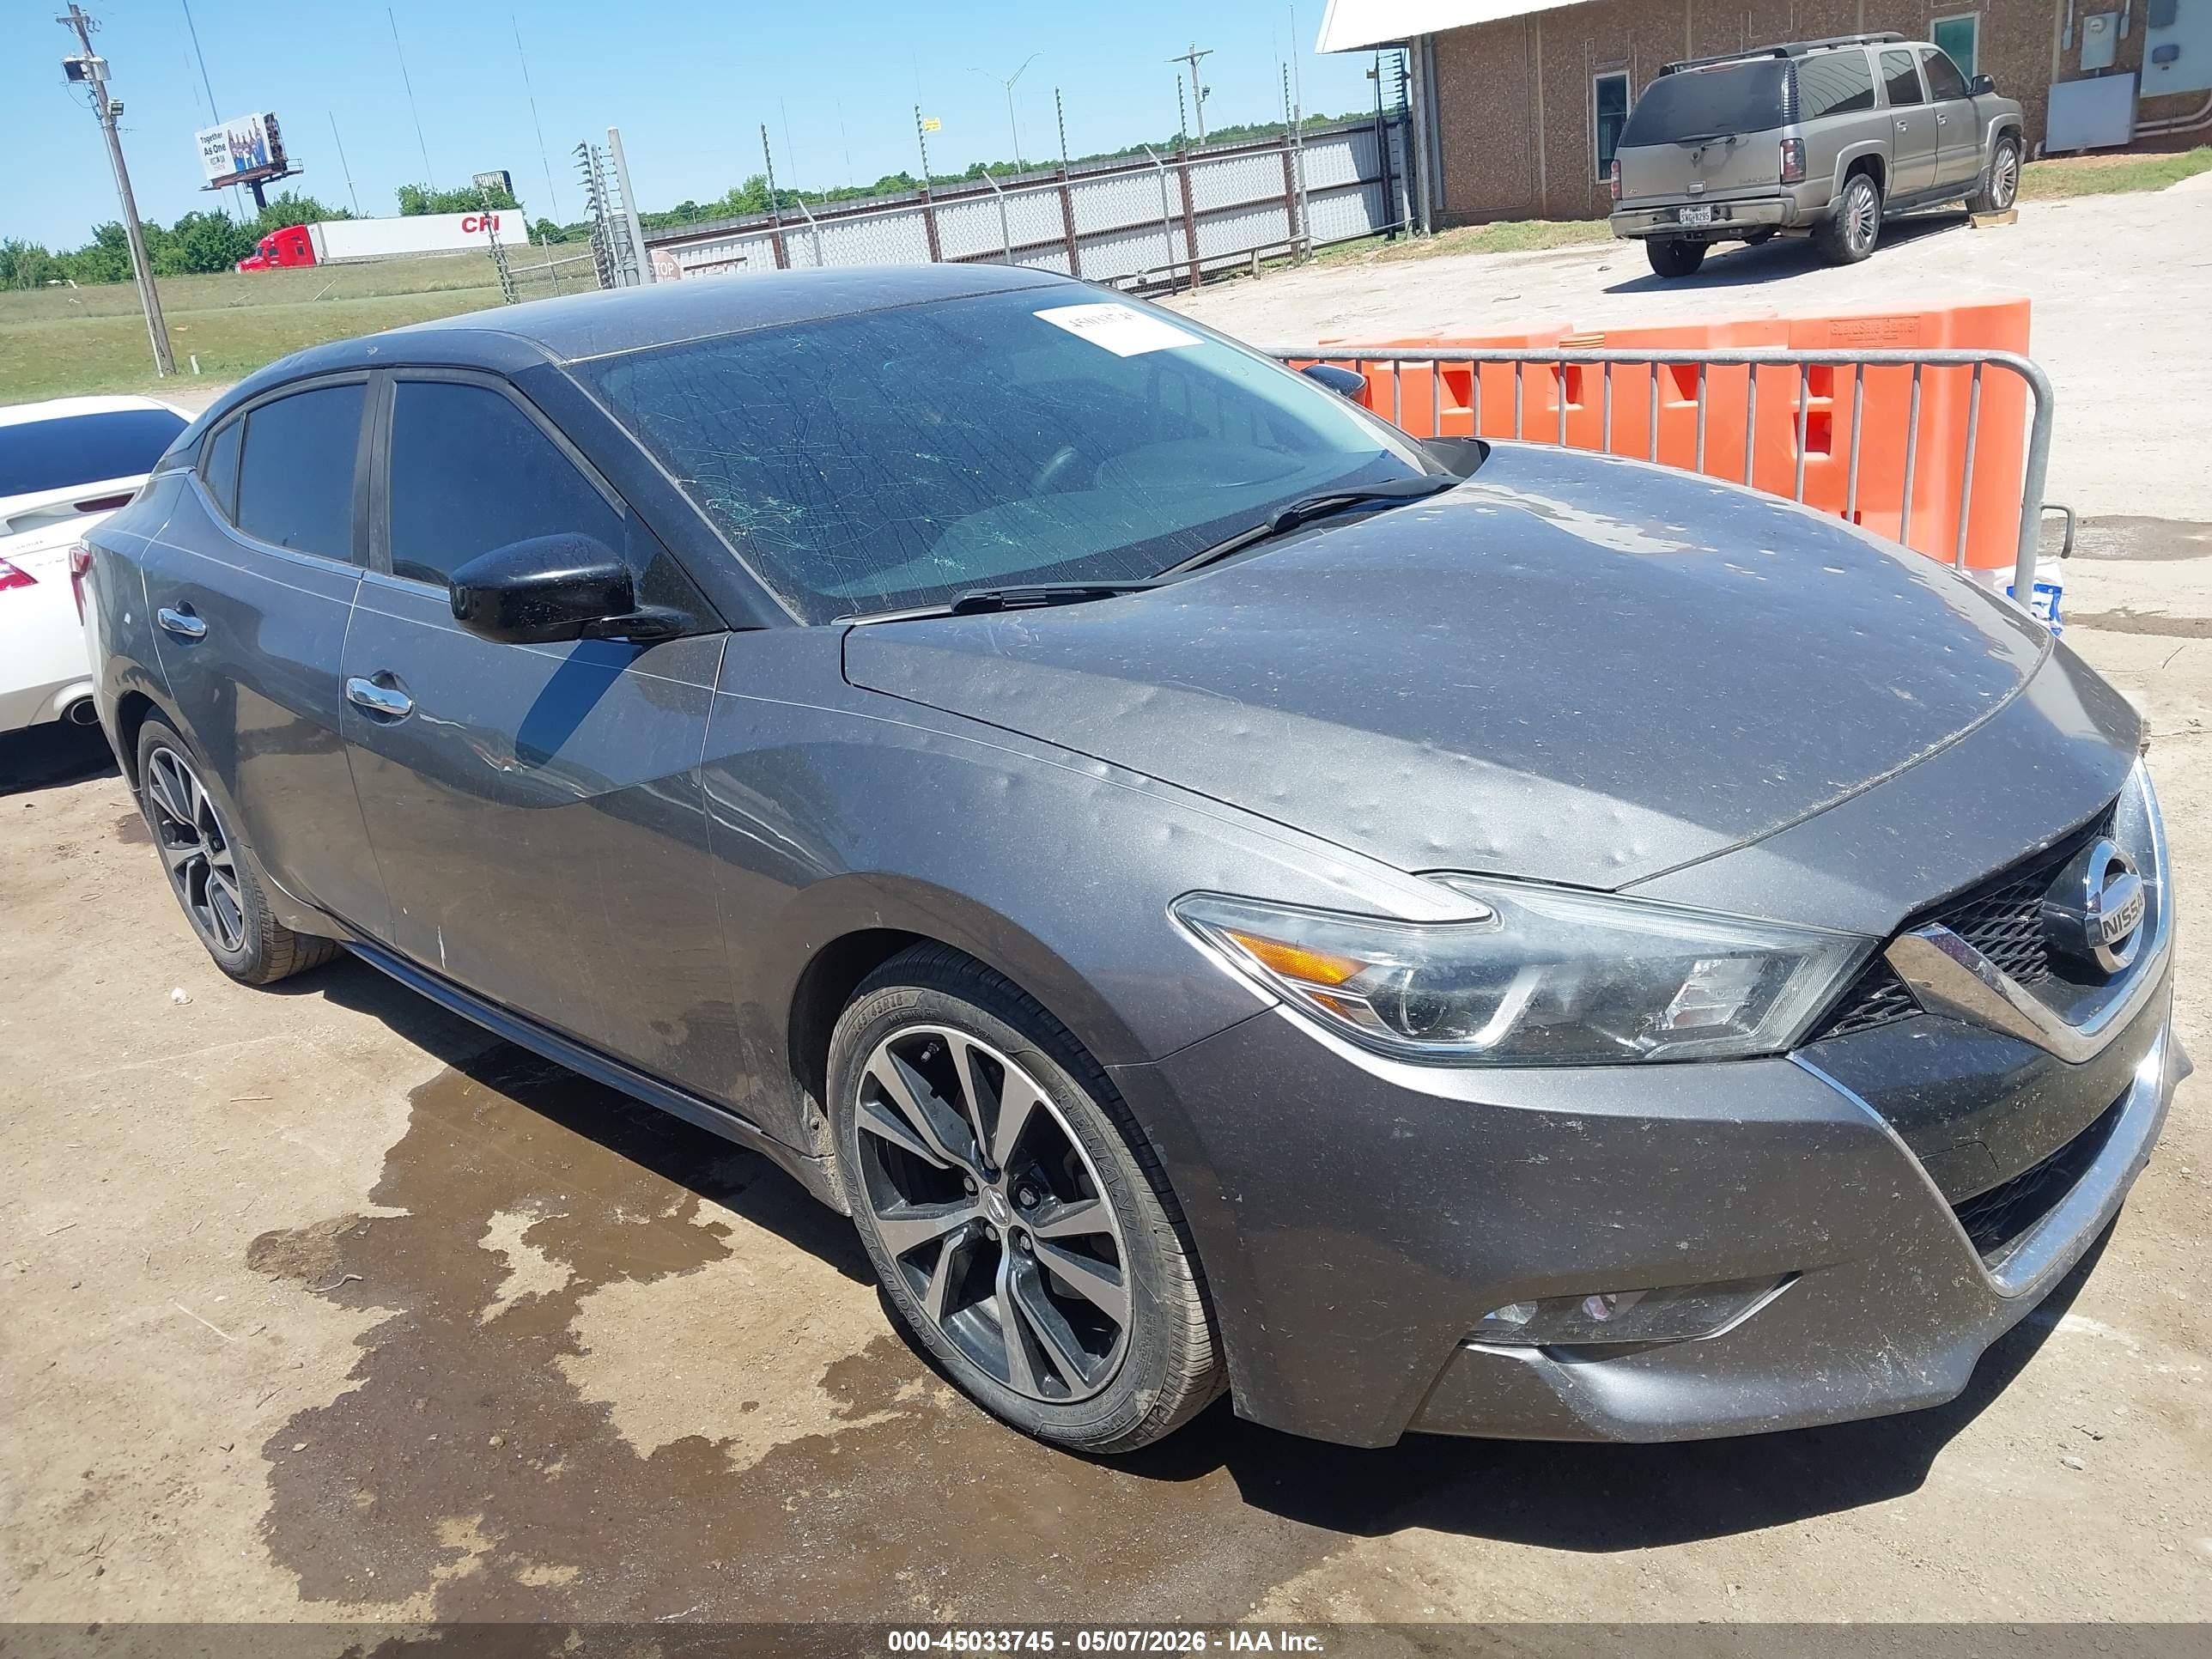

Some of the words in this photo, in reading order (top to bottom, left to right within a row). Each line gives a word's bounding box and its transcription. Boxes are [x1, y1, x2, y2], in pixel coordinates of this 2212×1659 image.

[200, 132, 223, 144] Together
[204, 147, 214, 156] As
[214, 143, 227, 154] One
[647, 262, 674, 276] STOP
